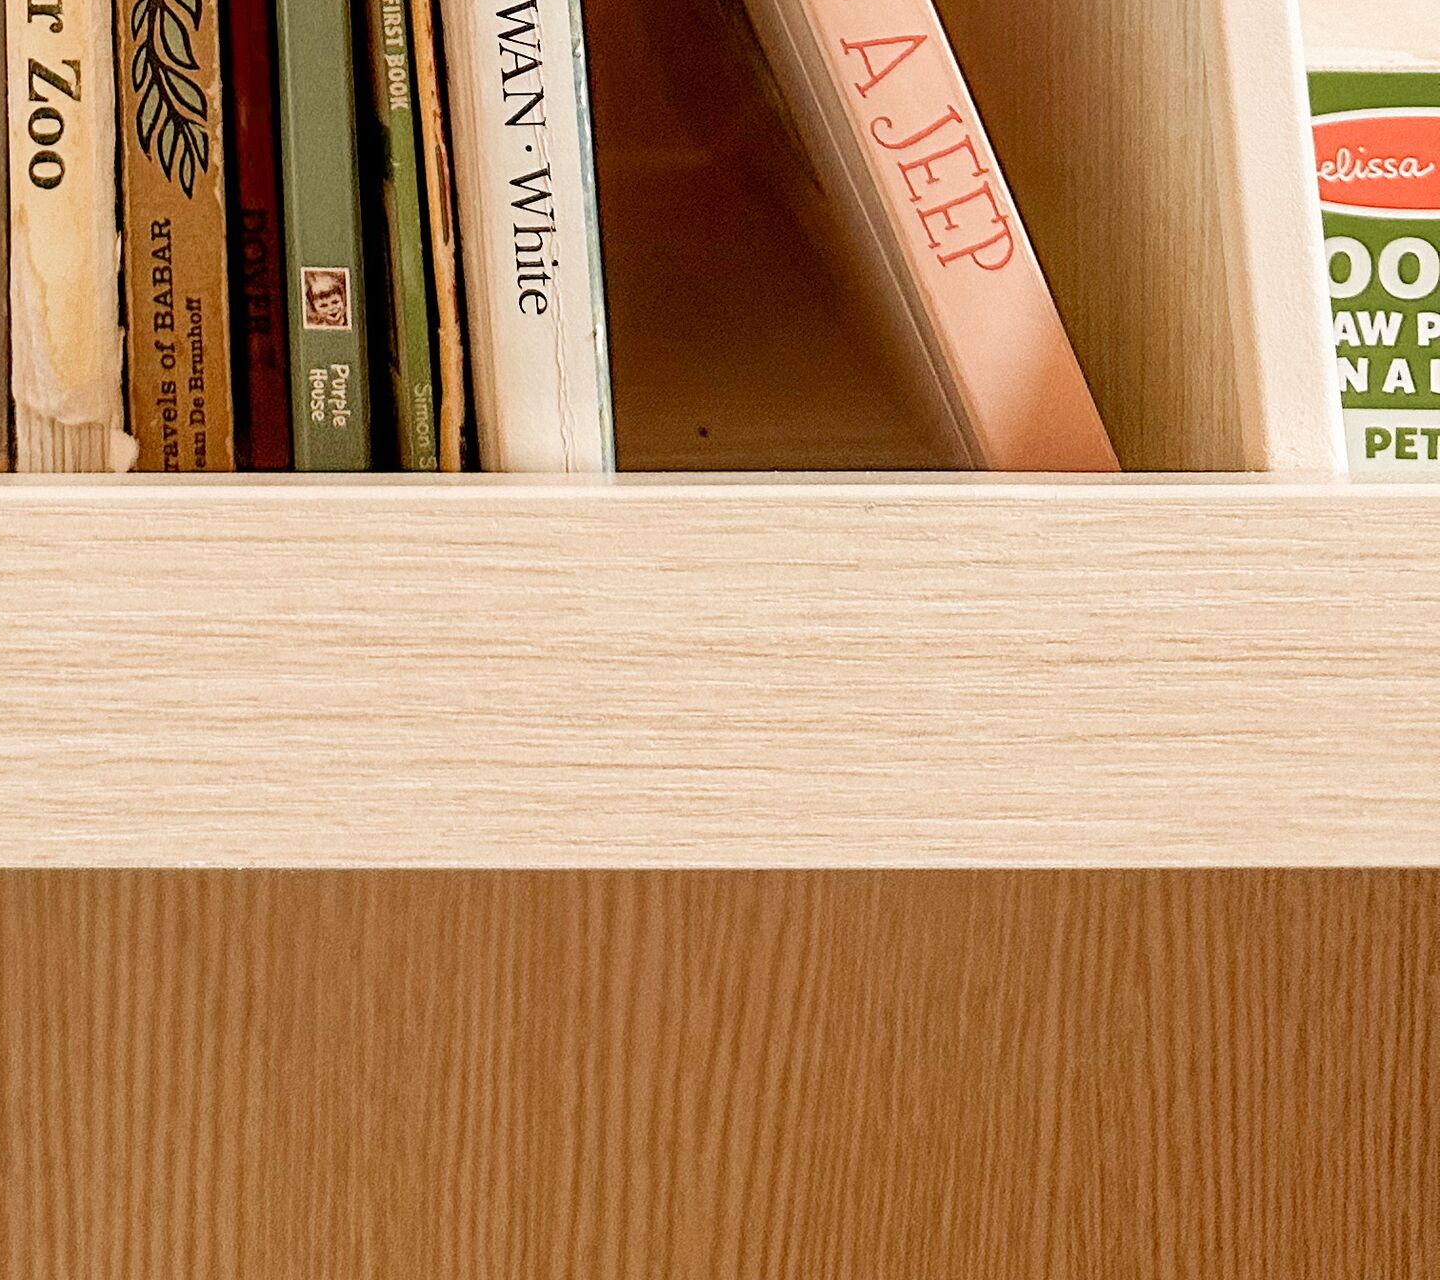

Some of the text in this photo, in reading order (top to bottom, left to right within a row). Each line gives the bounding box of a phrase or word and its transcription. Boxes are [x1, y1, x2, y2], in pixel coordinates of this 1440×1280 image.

[385, 53, 409, 111] BOOK
[840, 32, 930, 105] A
[27, 58, 82, 190] Zoo
[870, 101, 1018, 273] JEEP
[1317, 146, 1435, 182] elissa
[508, 162, 558, 316] White
[150, 217, 175, 333] BABAR
[154, 339, 177, 370] of
[185, 297, 205, 391] Brunhoff
[1382, 358, 1416, 394] A
[189, 393, 206, 426] De
[309, 368, 328, 422] House
[328, 363, 351, 428] Purple
[413, 384, 431, 448] Simon
